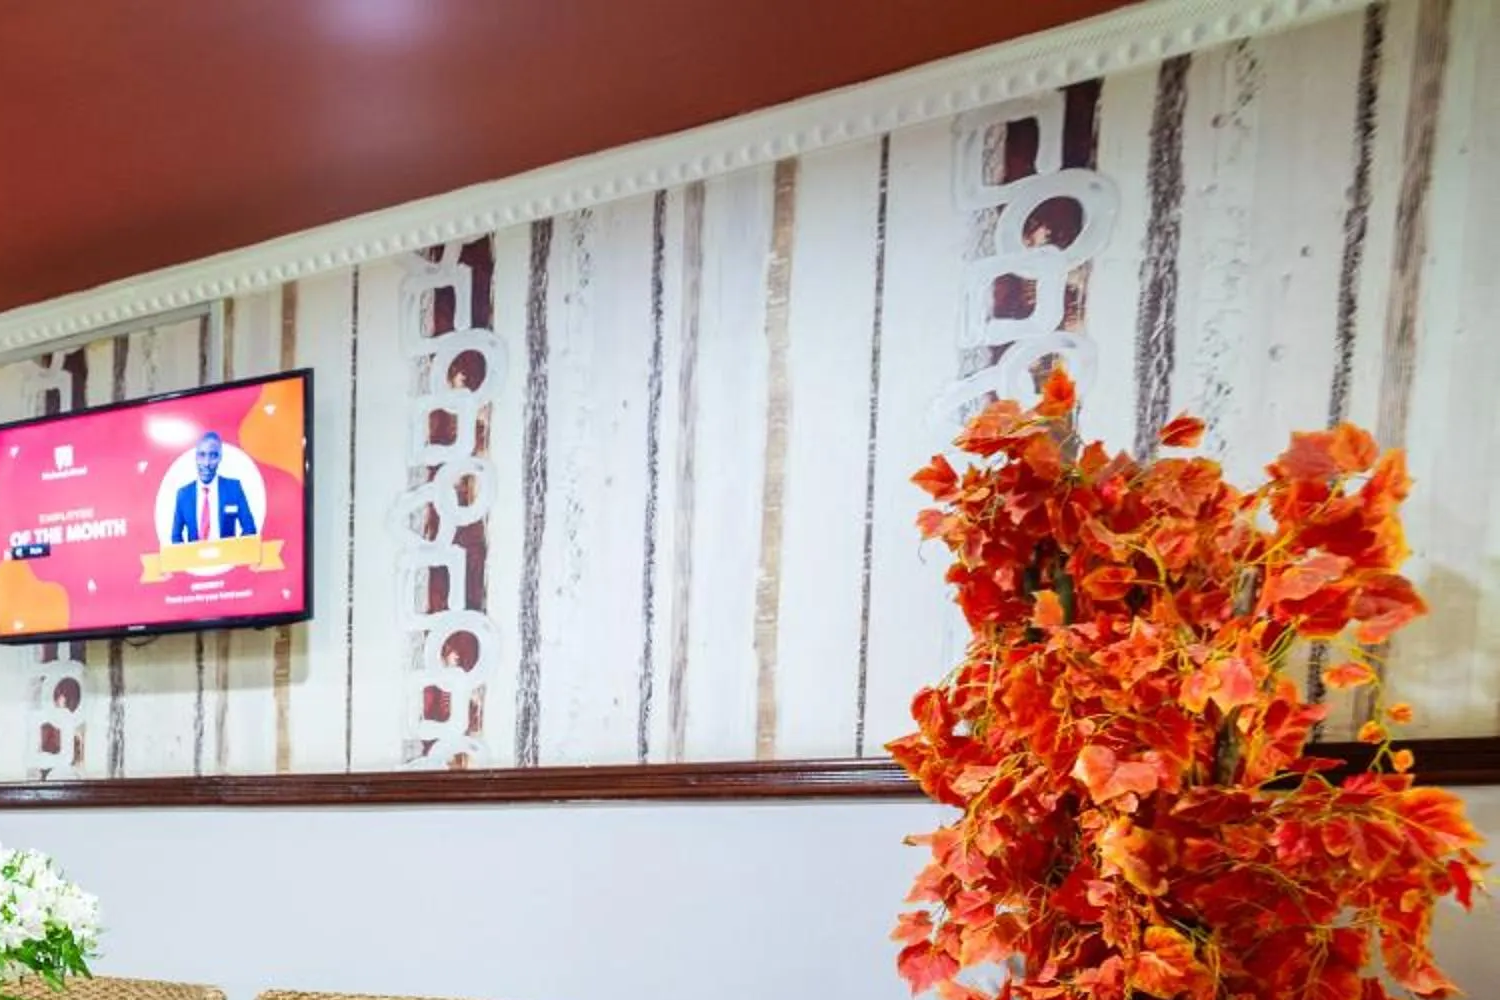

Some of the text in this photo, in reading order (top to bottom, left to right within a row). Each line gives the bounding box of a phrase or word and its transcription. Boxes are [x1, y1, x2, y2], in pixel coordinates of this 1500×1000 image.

[9, 518, 128, 547] OF THE MONTH
